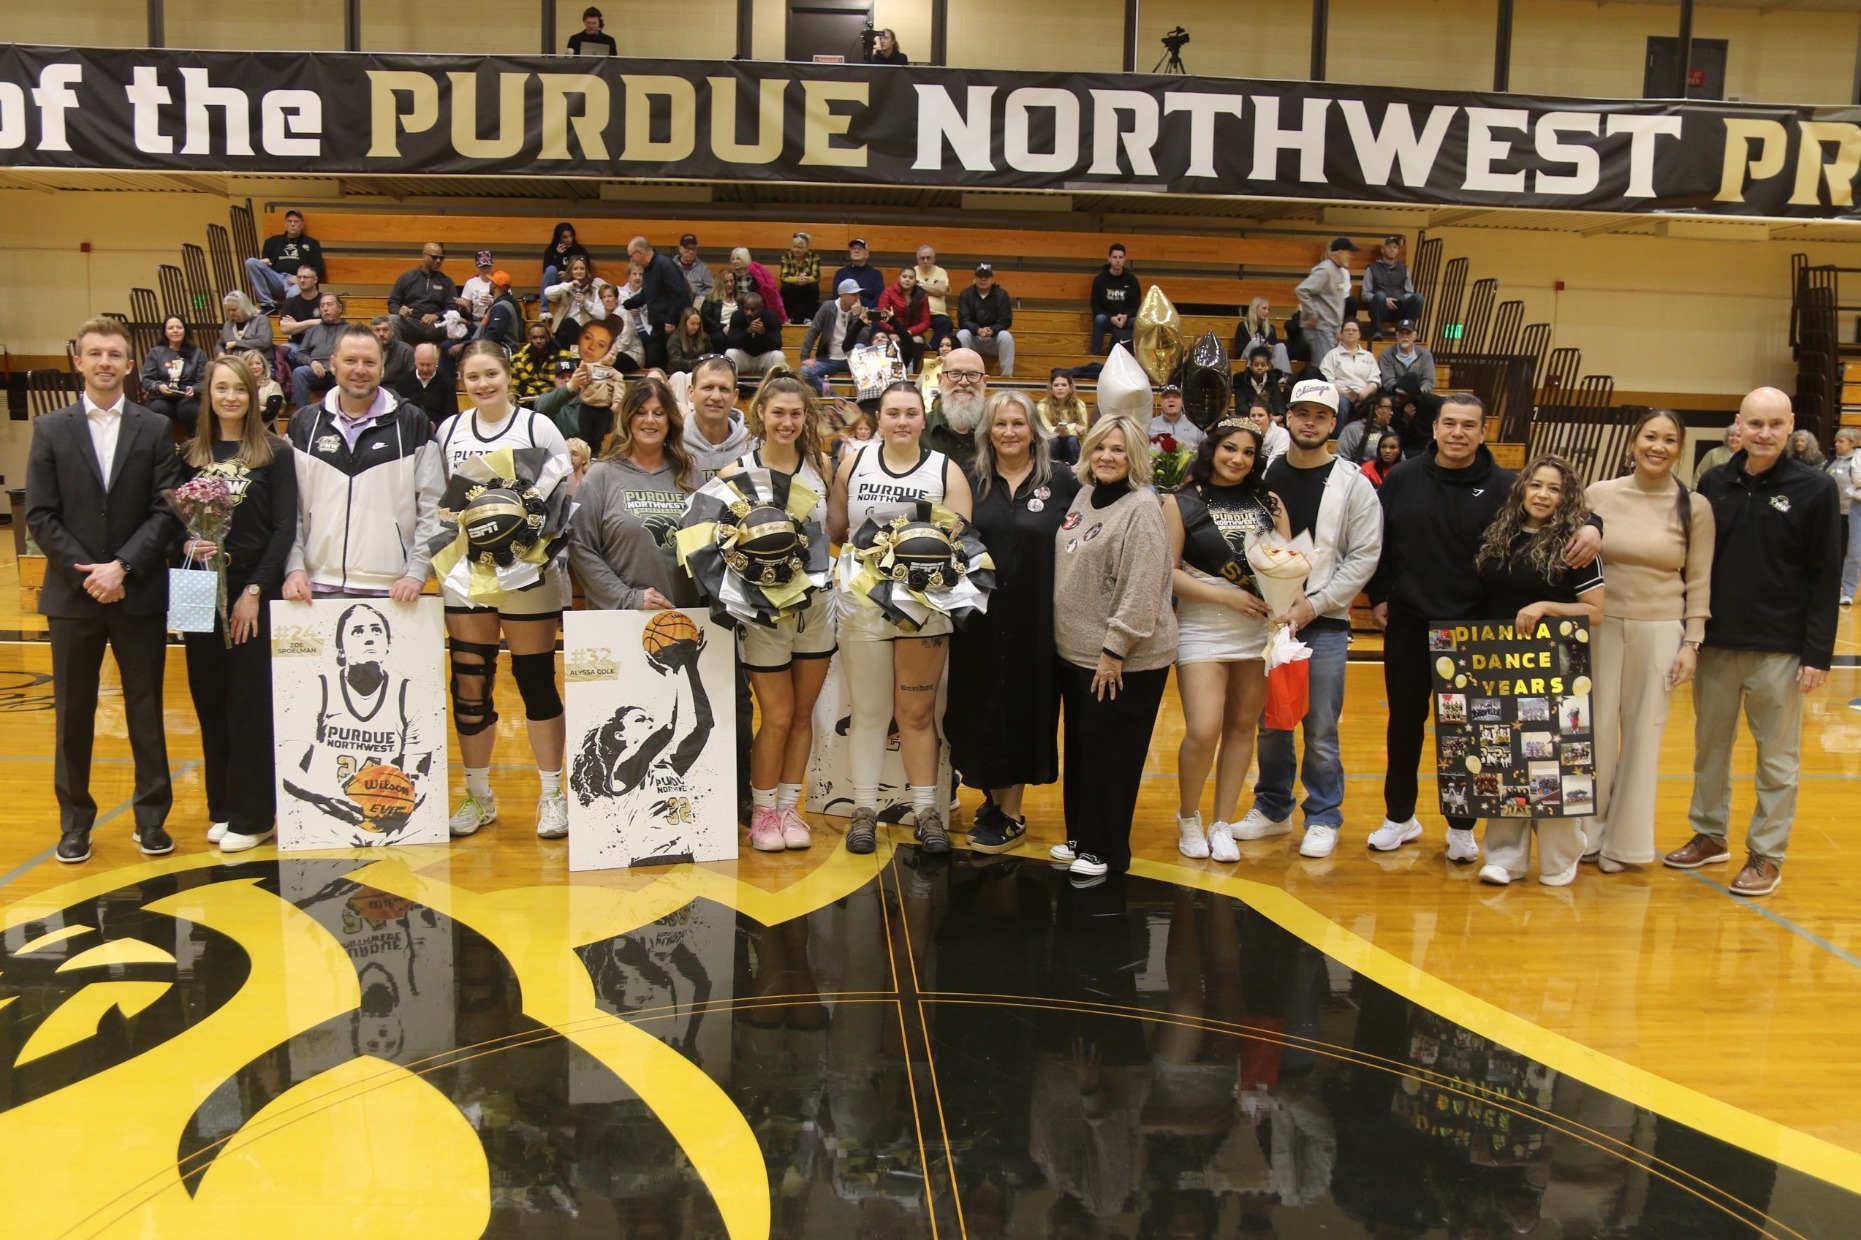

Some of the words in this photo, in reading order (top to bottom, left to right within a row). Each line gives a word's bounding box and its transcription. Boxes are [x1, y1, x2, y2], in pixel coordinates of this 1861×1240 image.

[125, 66, 322, 157] the
[366, 70, 870, 168] PURDUE
[912, 83, 1682, 199] NORTHWEST
[1713, 118, 1861, 207] PR
[1296, 385, 1330, 398] Chicago
[625, 491, 684, 503] PURDUE
[859, 483, 928, 500] PURDUE
[627, 501, 686, 510] NORTHWEST
[1213, 513, 1254, 521] PURDUE
[468, 520, 499, 539] ESPN
[570, 648, 611, 663] #32
[1472, 651, 1551, 670] DANCE
[1482, 676, 1564, 696] YEARS
[328, 726, 395, 744] PURDUE
[327, 739, 395, 753] NORTHWEST
[364, 779, 409, 796] Wilson
